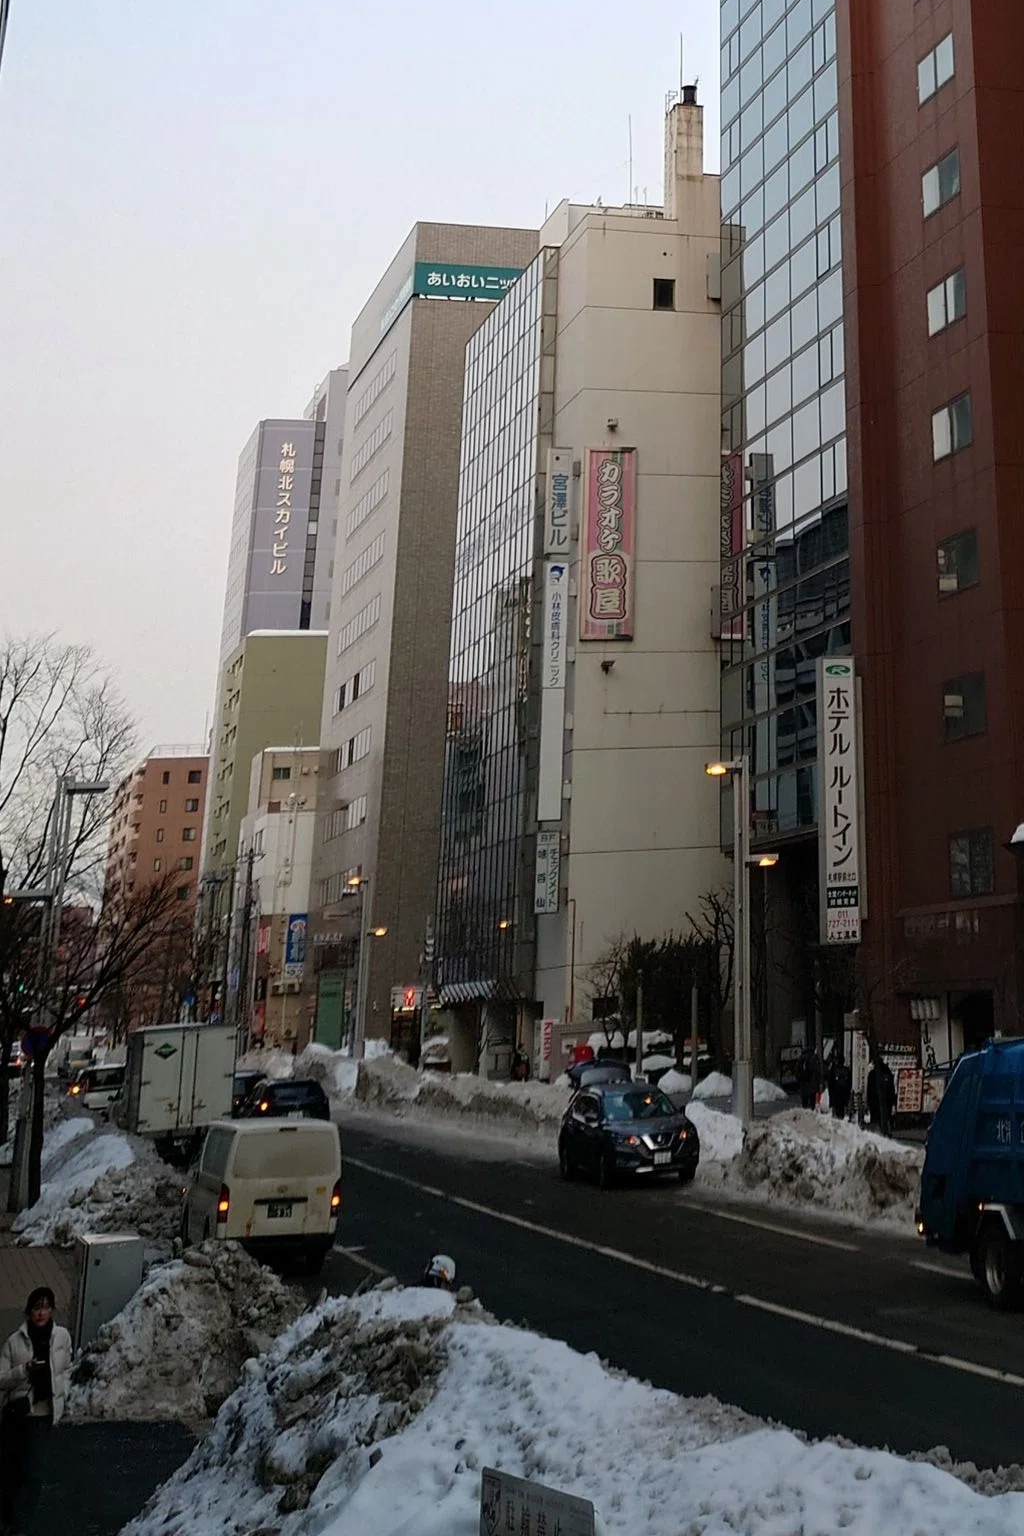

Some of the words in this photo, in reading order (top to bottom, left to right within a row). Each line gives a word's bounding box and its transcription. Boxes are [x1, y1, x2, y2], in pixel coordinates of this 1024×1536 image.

[270, 443, 296, 574] 札幌北スカイビル
[550, 473, 569, 546] 宮澤ビル
[828, 687, 850, 756] ホテル
[830, 766, 852, 867] ルートイン
[548, 849, 558, 907] チェックメイト
[544, 1021, 553, 1062] KIRIN
